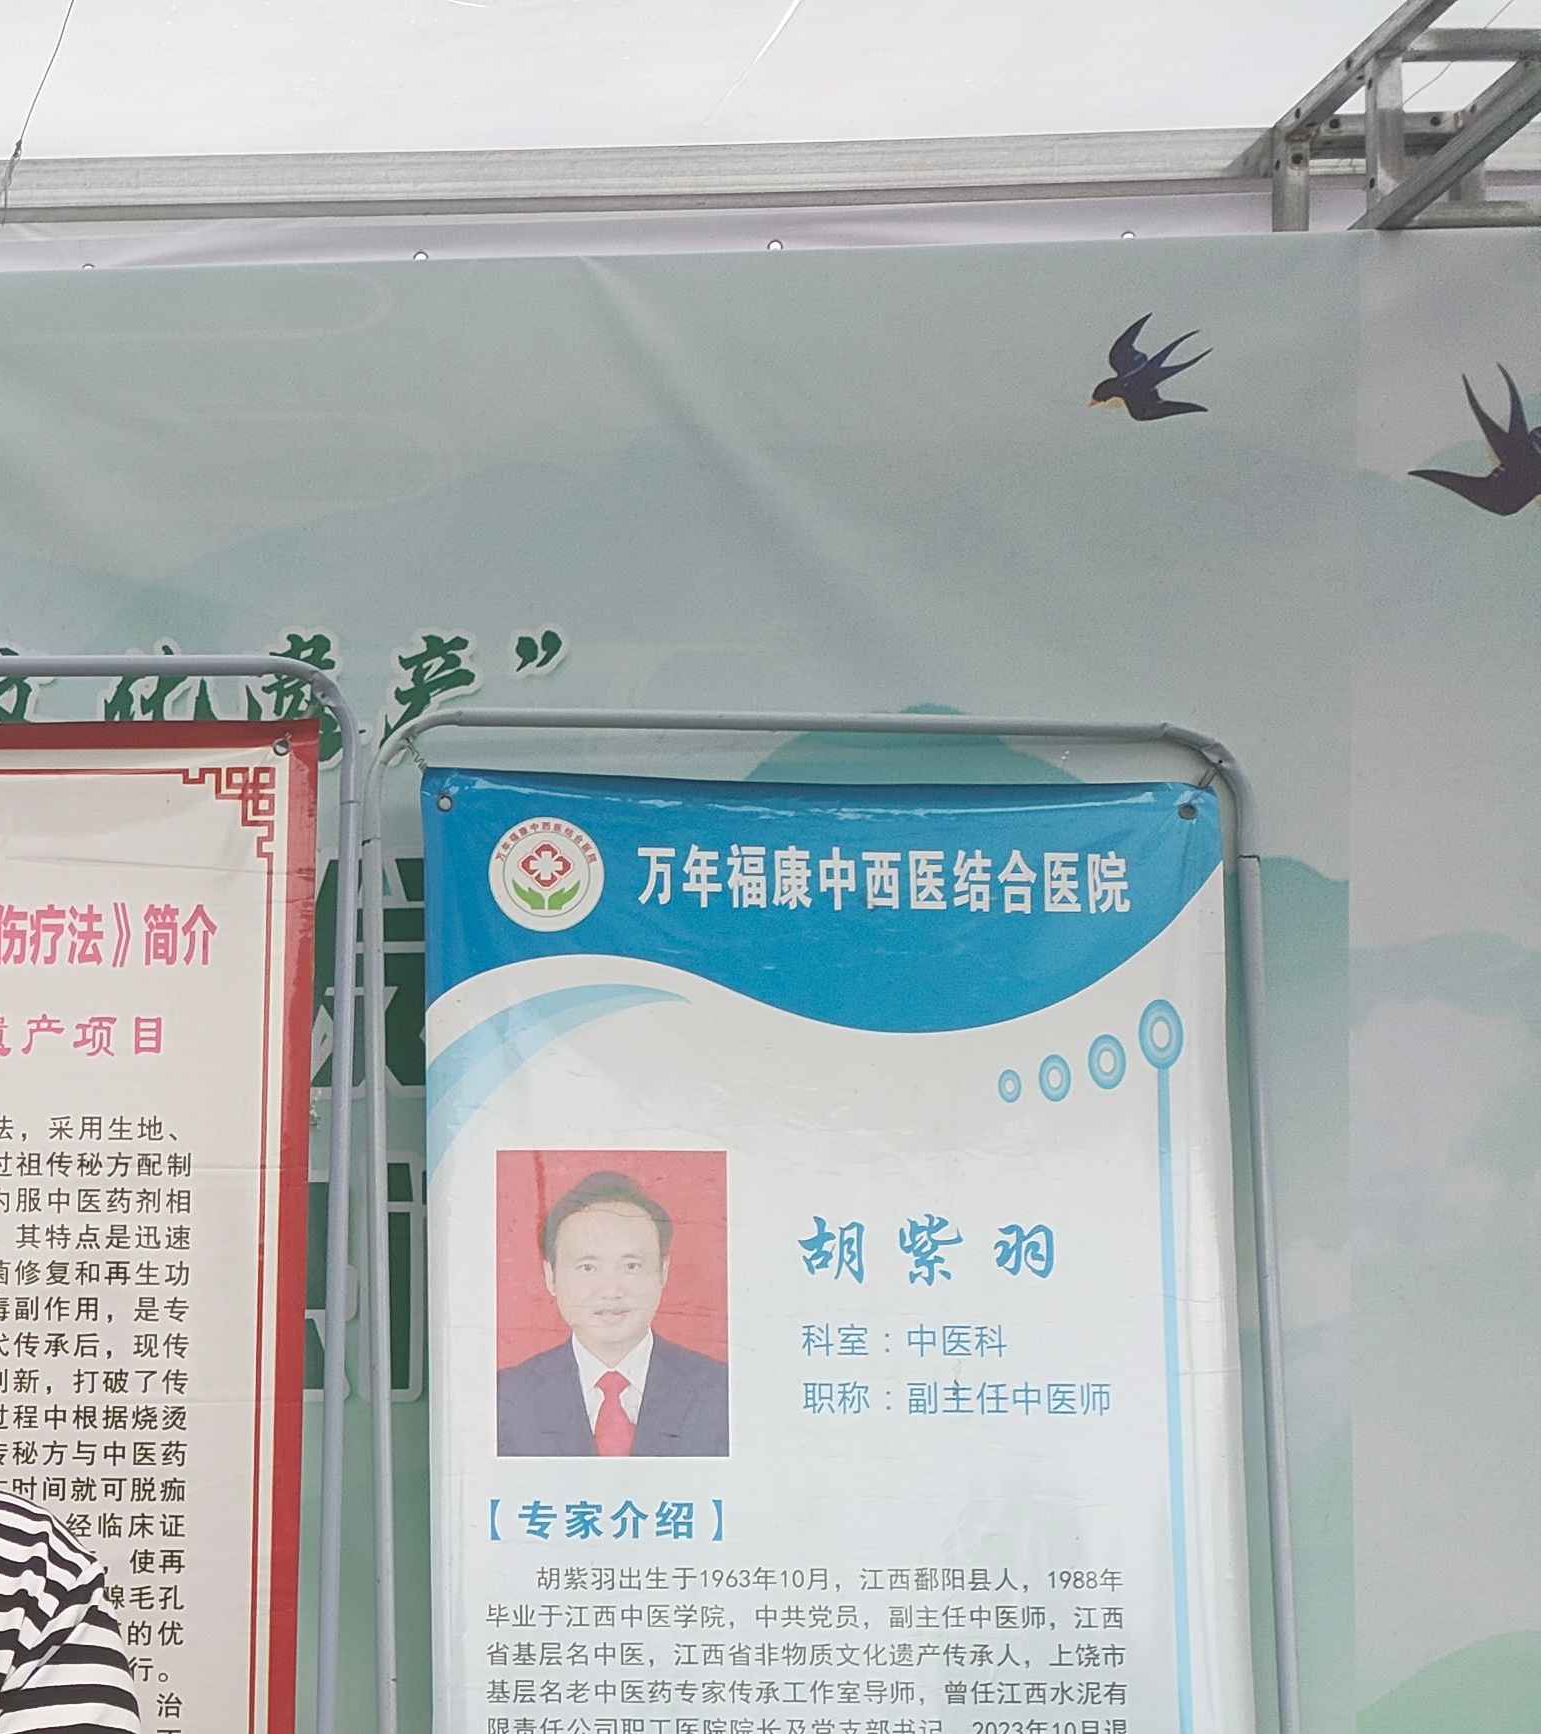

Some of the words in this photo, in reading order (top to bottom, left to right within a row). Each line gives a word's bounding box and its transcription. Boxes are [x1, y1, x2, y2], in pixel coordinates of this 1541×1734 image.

[636, 842, 1133, 918] 万年福康中西医结合医院
[797, 1212, 1057, 1287] 胡紫羽
[801, 1322, 1008, 1360] 科室：中医科
[802, 1379, 1113, 1418] 职称：副主任中医师
[68, 1512, 187, 1540] 经临床证
[486, 1497, 724, 1543] 【专家介绍】
[536, 1565, 1124, 1593] 胡紫羽出生于1963年10月，江西鄱阳县人，1988年
[485, 1603, 1124, 1630] 毕业于江西中医学院，中共党员，副主任中医师，江西
[485, 1641, 1126, 1669] 省基层名中医，江西省非物质文化遗产传承人，上饶市
[155, 1692, 184, 1719] 治
[485, 1679, 1127, 1706] 基层名老中医药专家传承工作室导师，曾任江西水泥有
